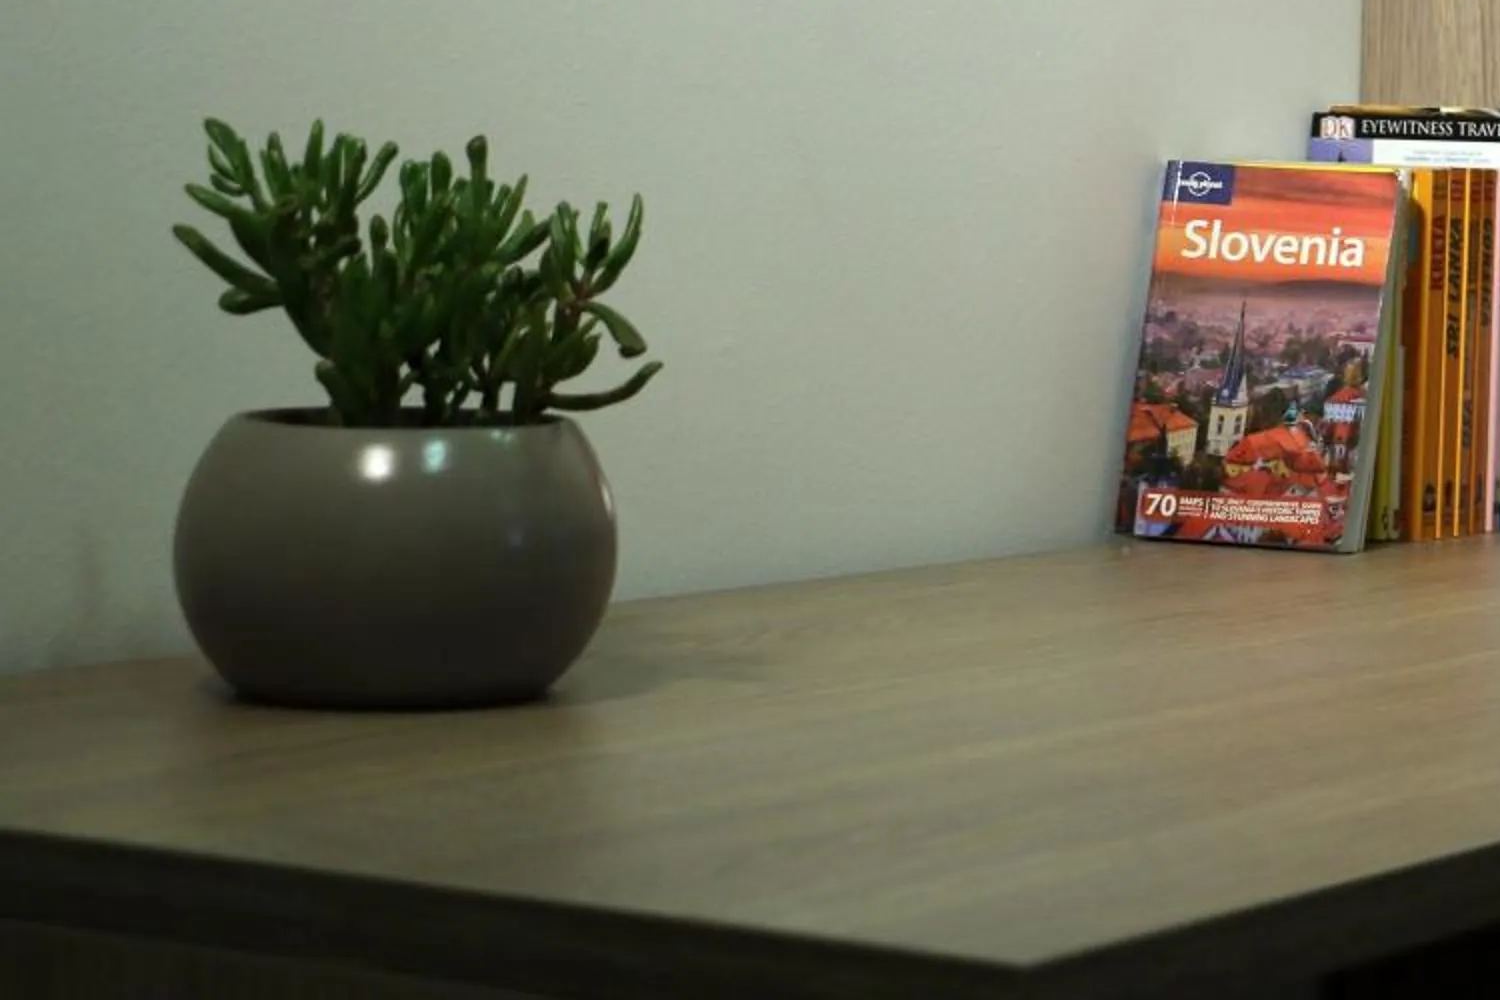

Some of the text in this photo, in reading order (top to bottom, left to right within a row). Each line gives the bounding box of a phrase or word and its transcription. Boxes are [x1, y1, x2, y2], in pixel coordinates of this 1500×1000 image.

[1320, 116, 1355, 139] DK
[1361, 119, 1454, 137] EYEWITNESS
[1180, 219, 1365, 267] Slovenia
[1446, 218, 1463, 358] SRI LANKA
[1145, 493, 1177, 518] 70
